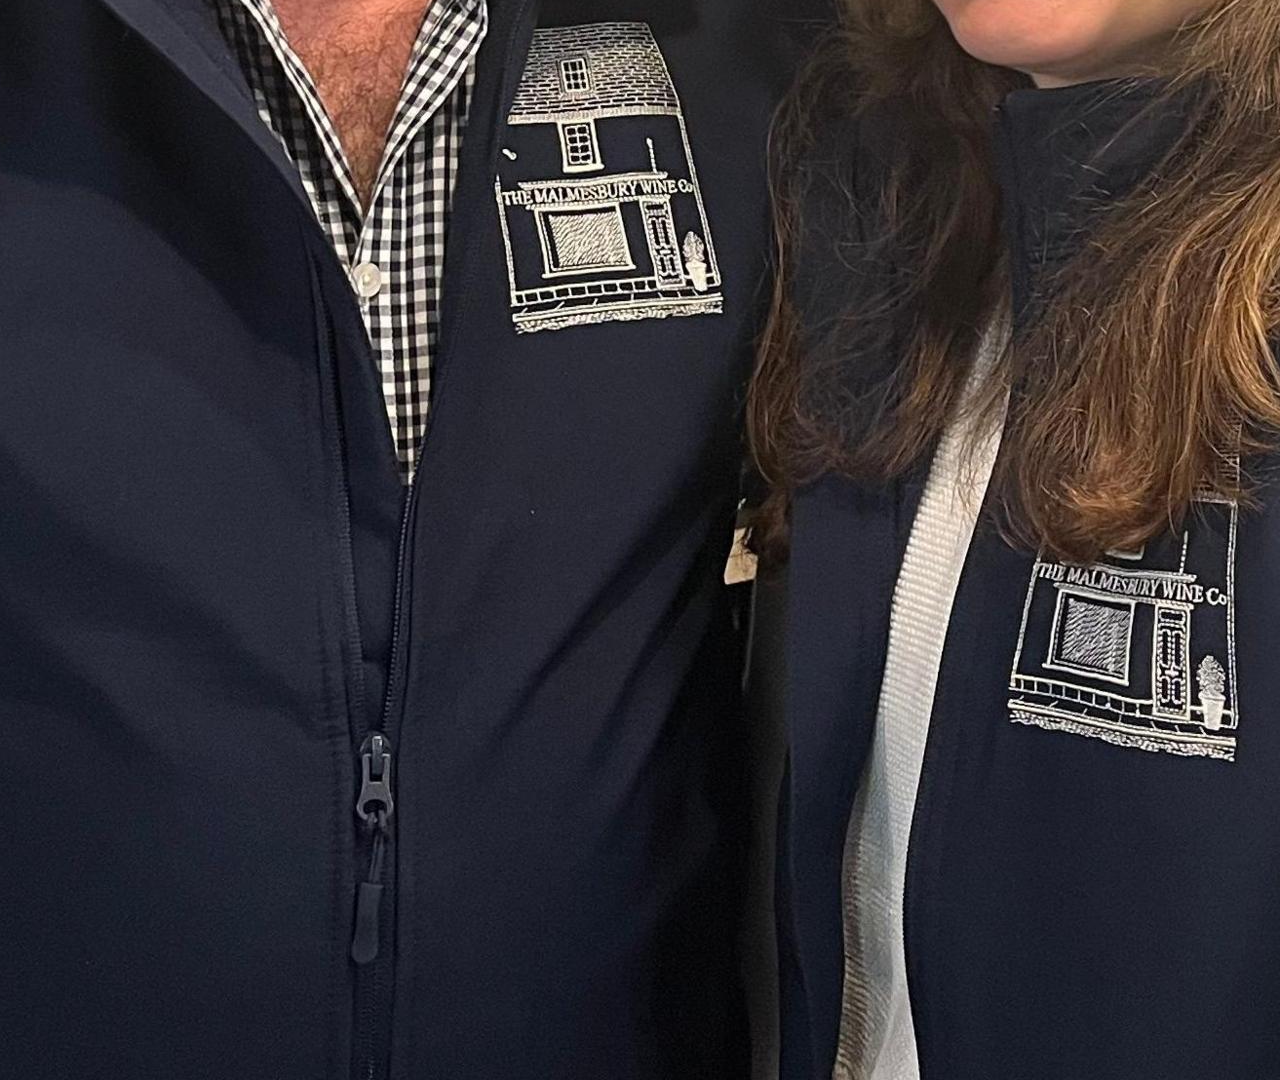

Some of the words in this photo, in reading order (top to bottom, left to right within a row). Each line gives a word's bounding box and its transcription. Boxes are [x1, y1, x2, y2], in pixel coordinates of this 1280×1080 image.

[502, 189, 533, 207] THE
[534, 180, 638, 204] MALMESBURY
[639, 179, 678, 198] WINE
[1038, 562, 1063, 582] THE
[1069, 567, 1160, 598] MALMESBURY
[1161, 578, 1204, 602] WINE
